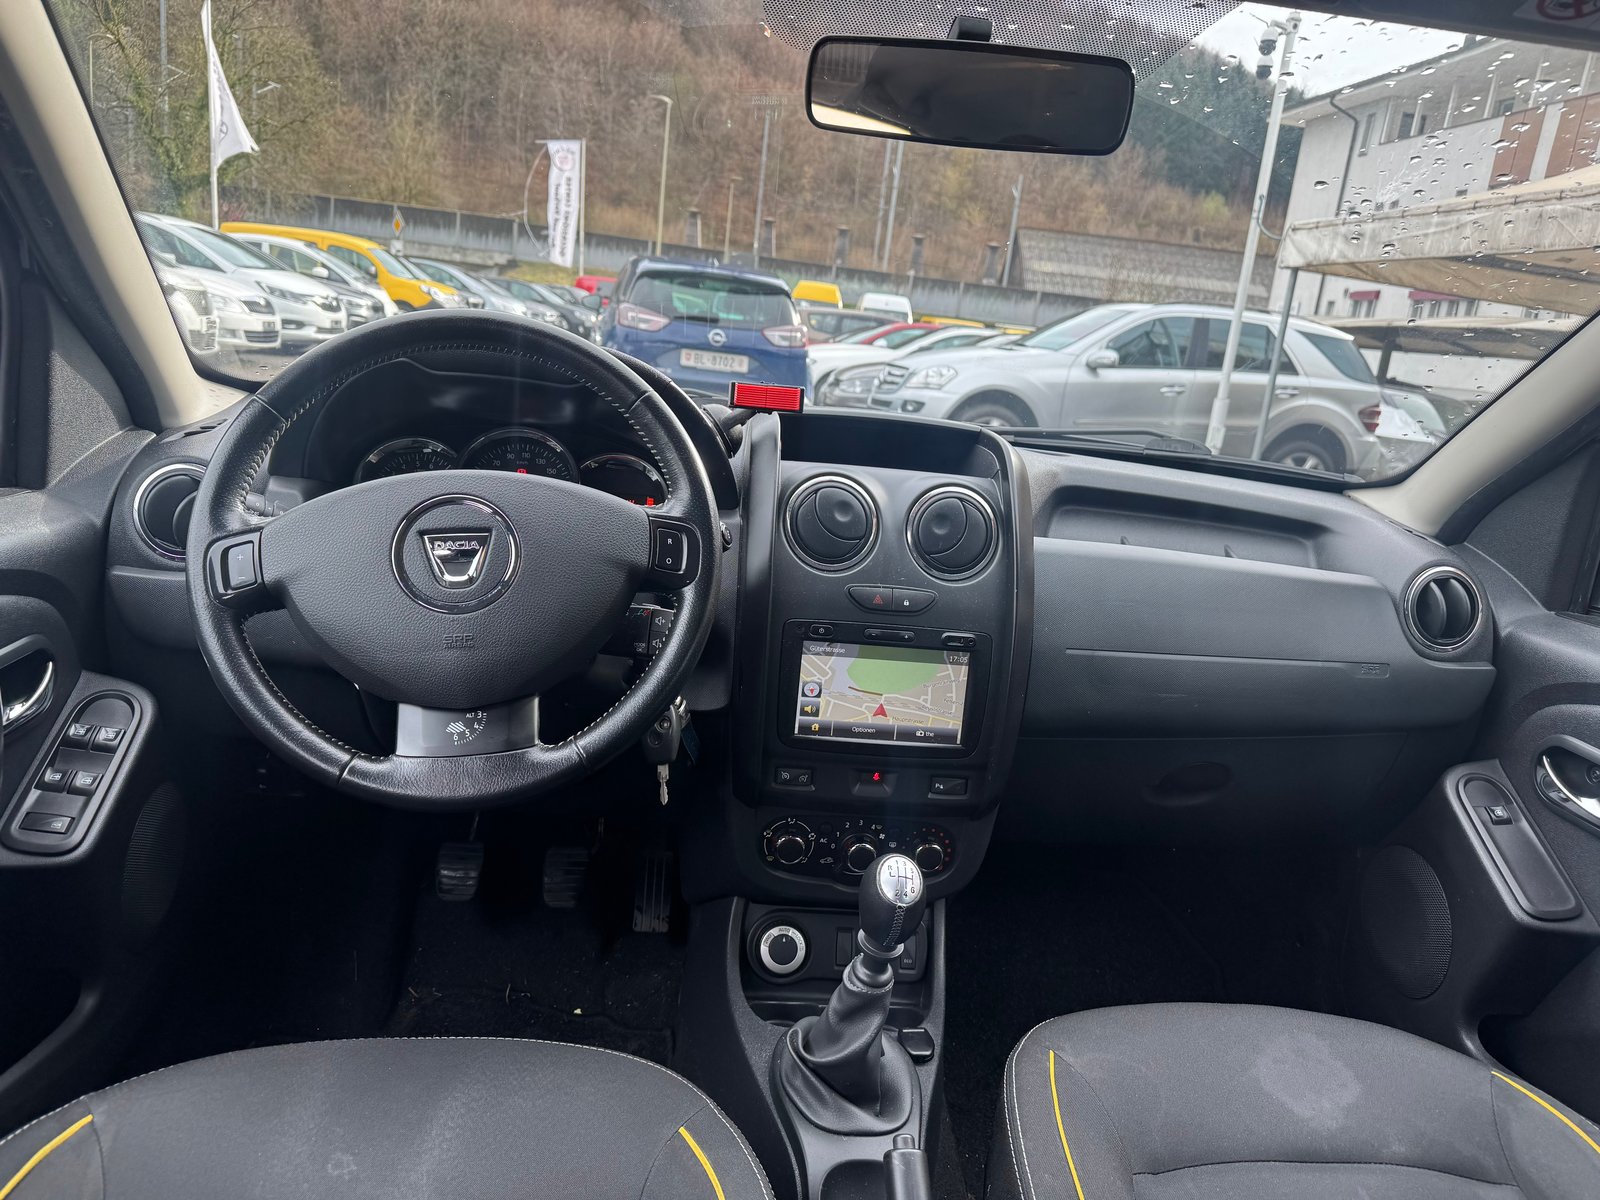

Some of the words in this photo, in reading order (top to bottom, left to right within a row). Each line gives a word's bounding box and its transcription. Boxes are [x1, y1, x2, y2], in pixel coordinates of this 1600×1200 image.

[546, 467, 557, 475] 150
[433, 540, 480, 550] DACIA
[949, 655, 968, 663] 17:05
[476, 710, 482, 719] 3
[473, 721, 479, 729] 4
[465, 728, 470, 737] 5
[851, 726, 876, 734] Optionen
[453, 733, 459, 741] 6
